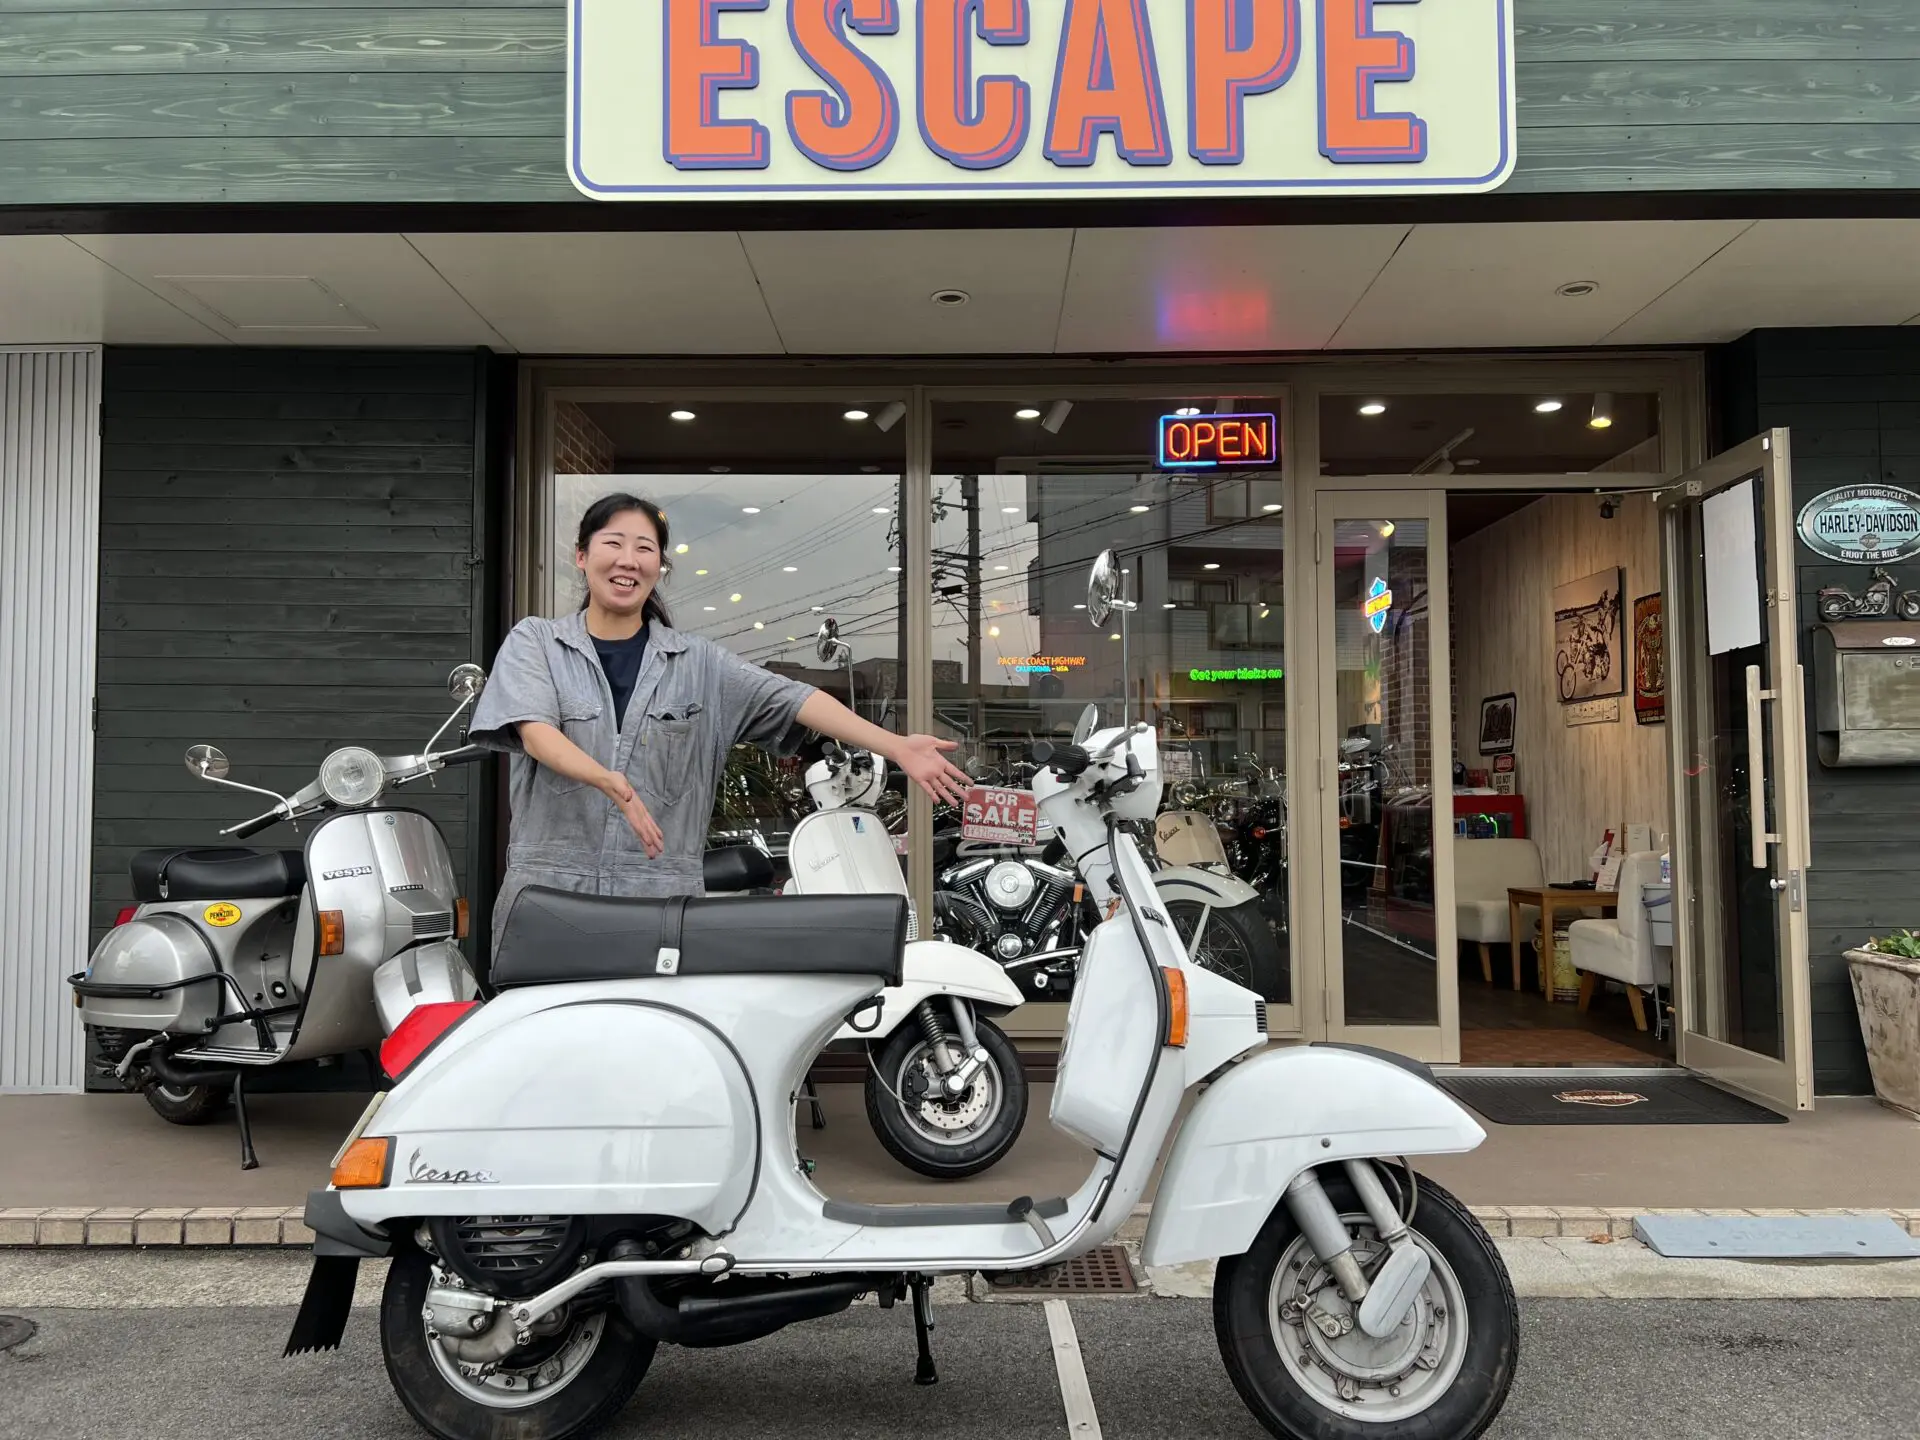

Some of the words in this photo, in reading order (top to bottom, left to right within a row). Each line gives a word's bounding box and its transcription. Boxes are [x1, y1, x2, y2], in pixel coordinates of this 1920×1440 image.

[663, 0, 1427, 169] ESCAPE
[1167, 421, 1267, 458] OPEN
[1826, 489, 1855, 502] QUALITY
[1857, 488, 1908, 501] MOTORCYCLES
[1820, 513, 1918, 533] HARLEY-DAVIDSON
[1841, 549, 1864, 559] ENJOY
[1866, 551, 1880, 559] THE
[1882, 548, 1899, 558] RIDE
[998, 656, 1025, 665] PACIFIC
[1026, 656, 1051, 666] COAST
[1051, 656, 1085, 666] HIGHWAY
[984, 791, 1018, 806] FOR
[966, 803, 1035, 828] SALE
[324, 865, 372, 880] vespa
[406, 1147, 498, 1184] Vespa
